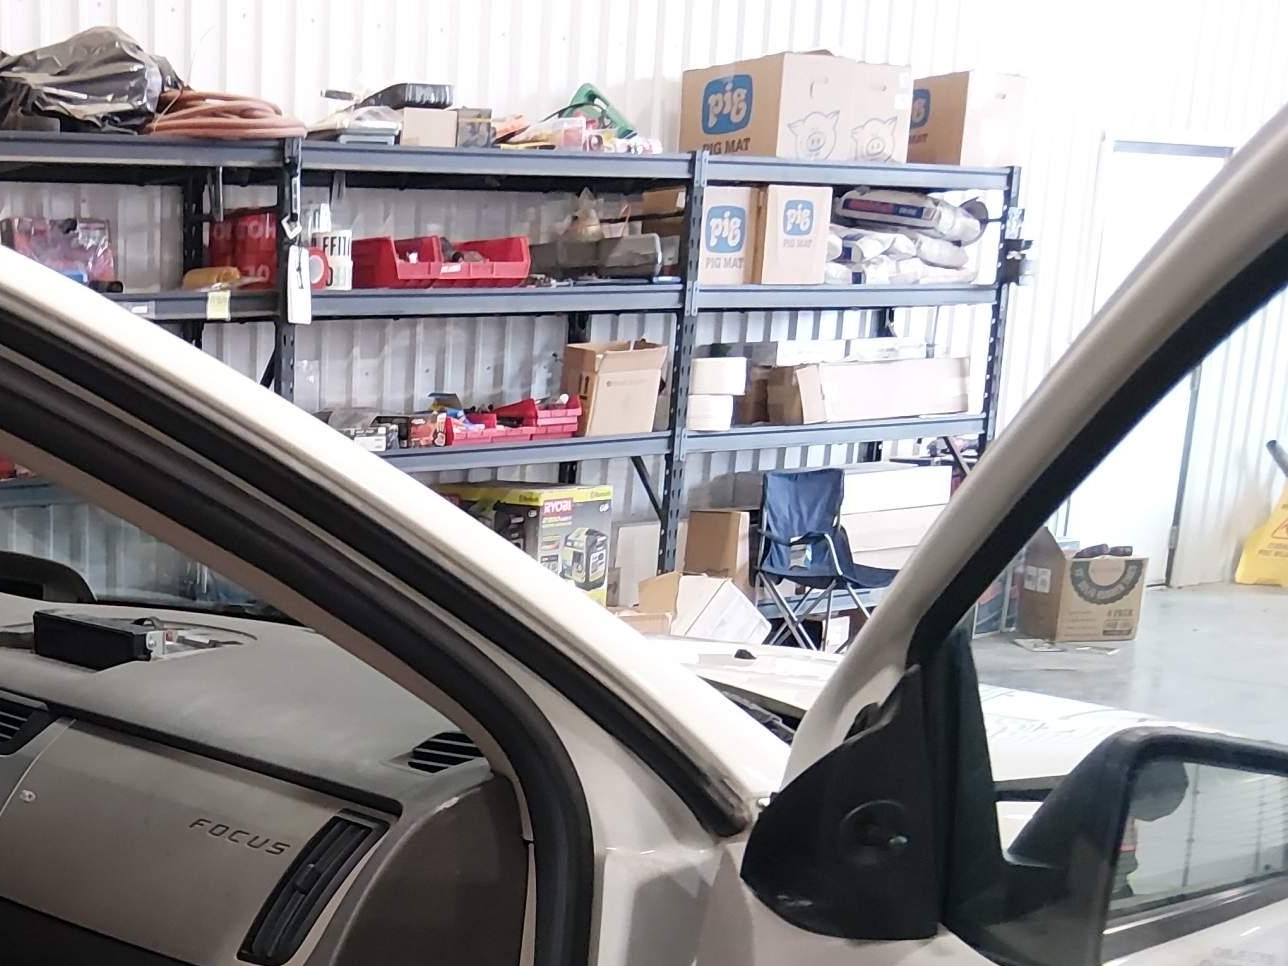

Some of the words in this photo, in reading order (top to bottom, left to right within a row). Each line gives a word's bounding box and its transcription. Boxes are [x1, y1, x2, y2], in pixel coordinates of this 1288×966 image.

[707, 82, 748, 128] pig
[725, 137, 751, 154] MAT
[709, 210, 742, 246] pig
[785, 202, 810, 231] pig
[705, 256, 721, 270] PIG
[723, 257, 744, 270] MAT
[543, 499, 572, 514] RYOBI
[189, 818, 291, 855] FOCUS
